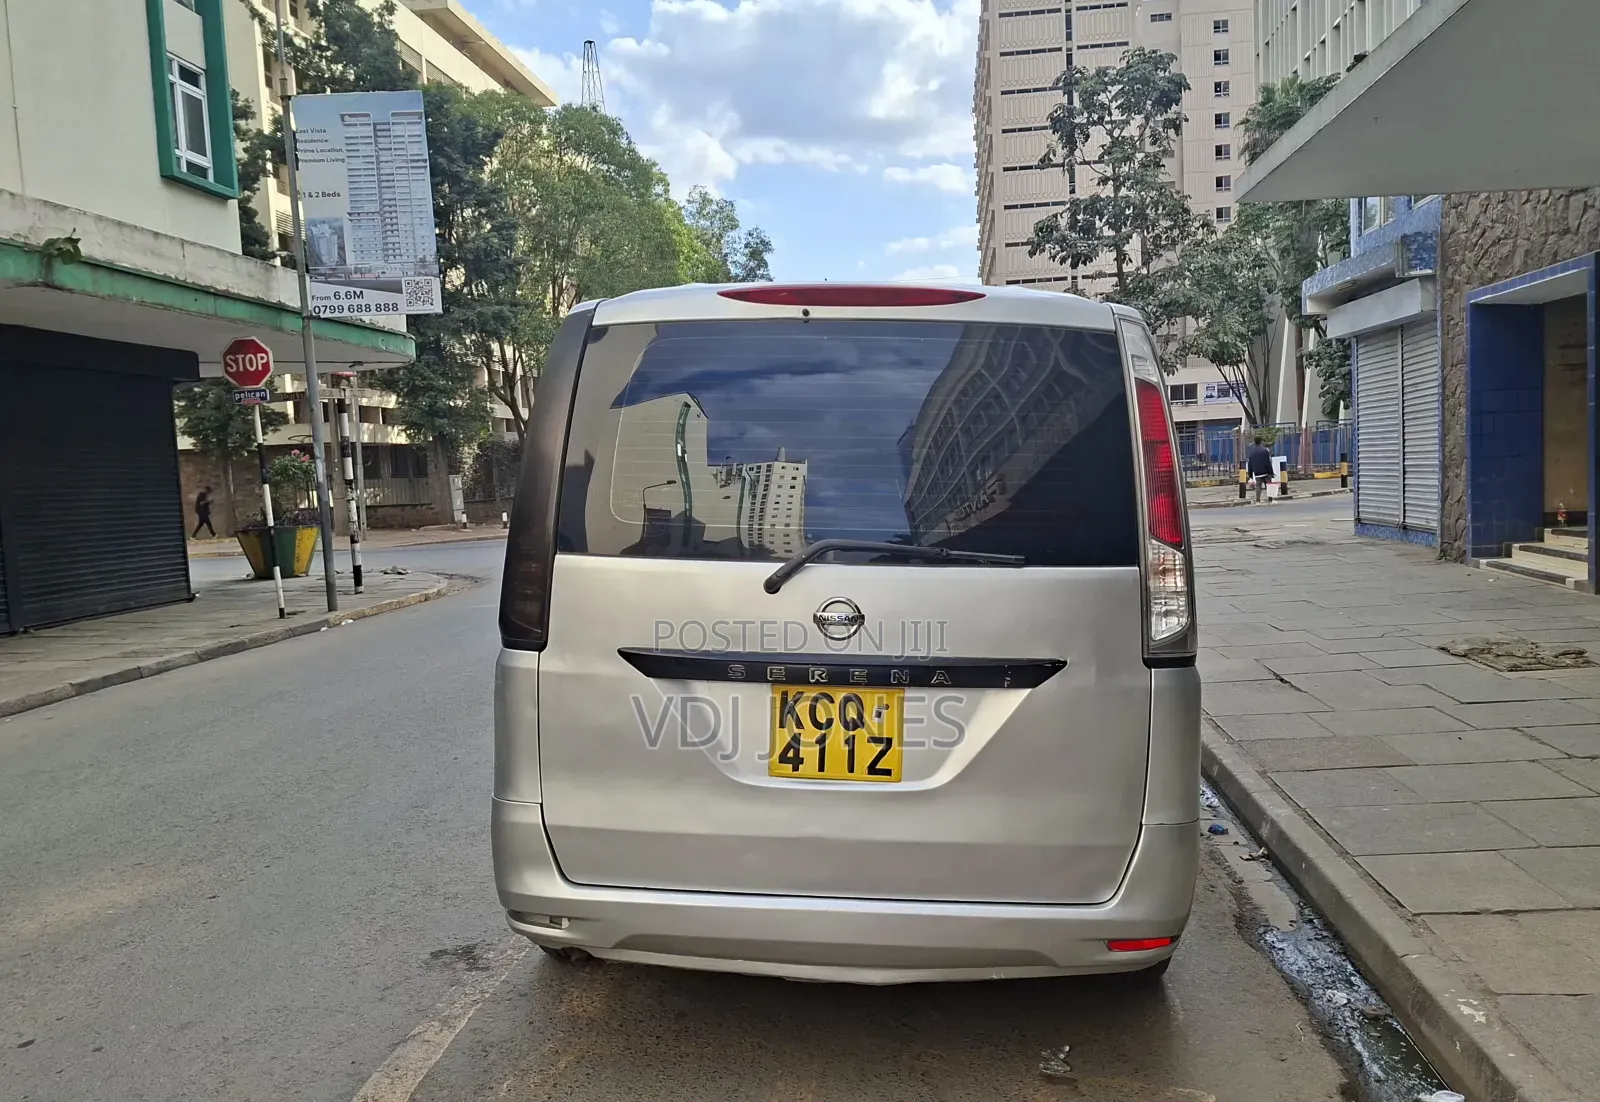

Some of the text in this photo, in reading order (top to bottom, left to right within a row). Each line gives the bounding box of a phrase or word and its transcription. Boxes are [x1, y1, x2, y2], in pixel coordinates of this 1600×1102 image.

[321, 190, 341, 198] Beds
[333, 290, 364, 301] 6.6M
[313, 304, 345, 315] 0799
[347, 303, 372, 314] 688
[374, 302, 399, 313] 888
[225, 352, 268, 373] STOP
[235, 391, 266, 400] pelican
[818, 614, 859, 622] NISSAN
[727, 664, 952, 685] SERENA
[778, 690, 865, 732] KCQ
[778, 733, 893, 777] 411Z
